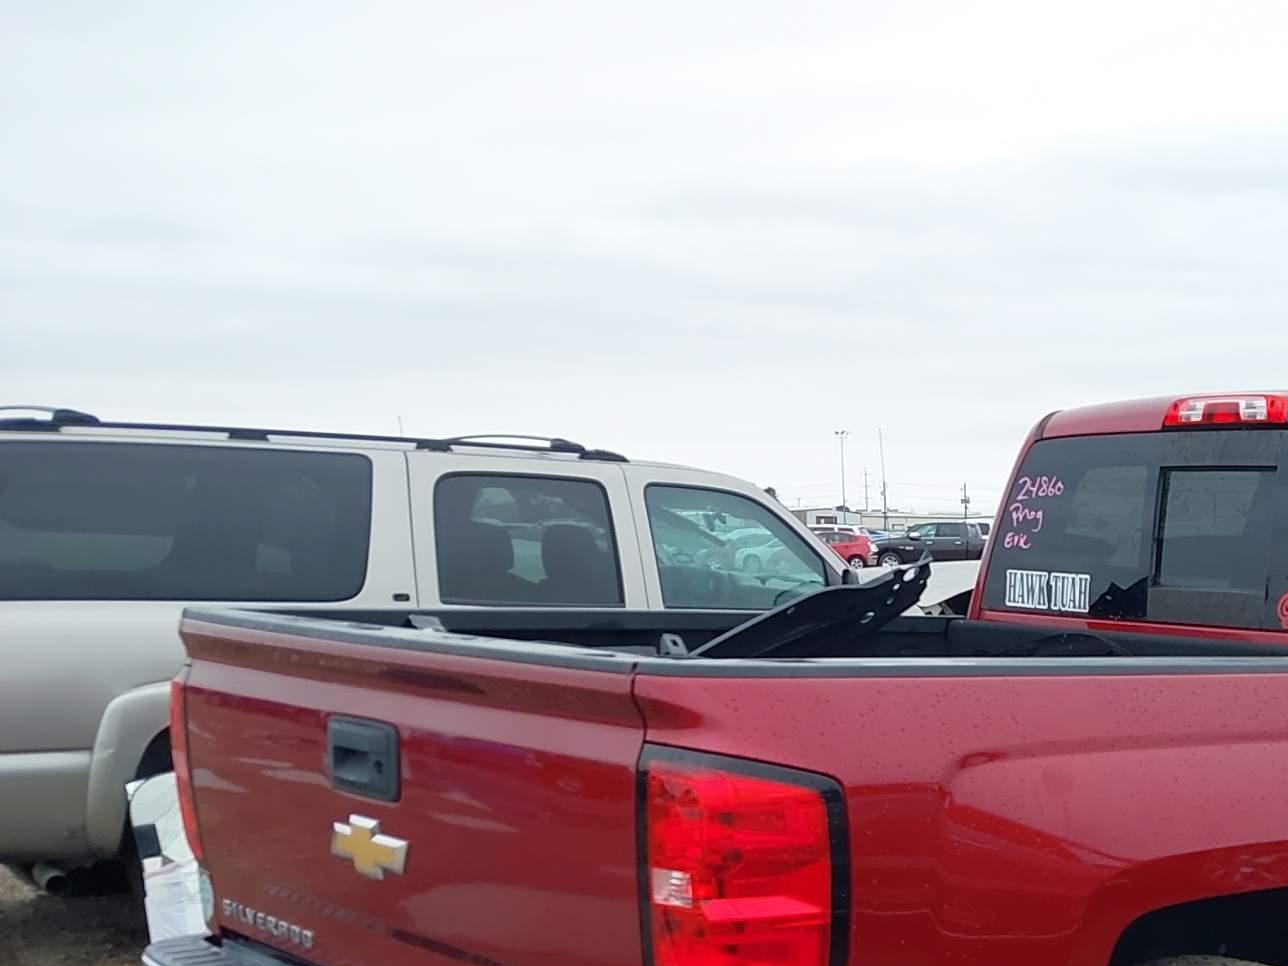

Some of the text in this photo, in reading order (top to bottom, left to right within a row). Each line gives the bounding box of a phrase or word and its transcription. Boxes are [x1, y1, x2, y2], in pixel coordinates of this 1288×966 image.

[1016, 475, 1064, 500] 24860
[1005, 569, 1091, 613] HAWK TUAH
[222, 898, 315, 947] SILVERADO
